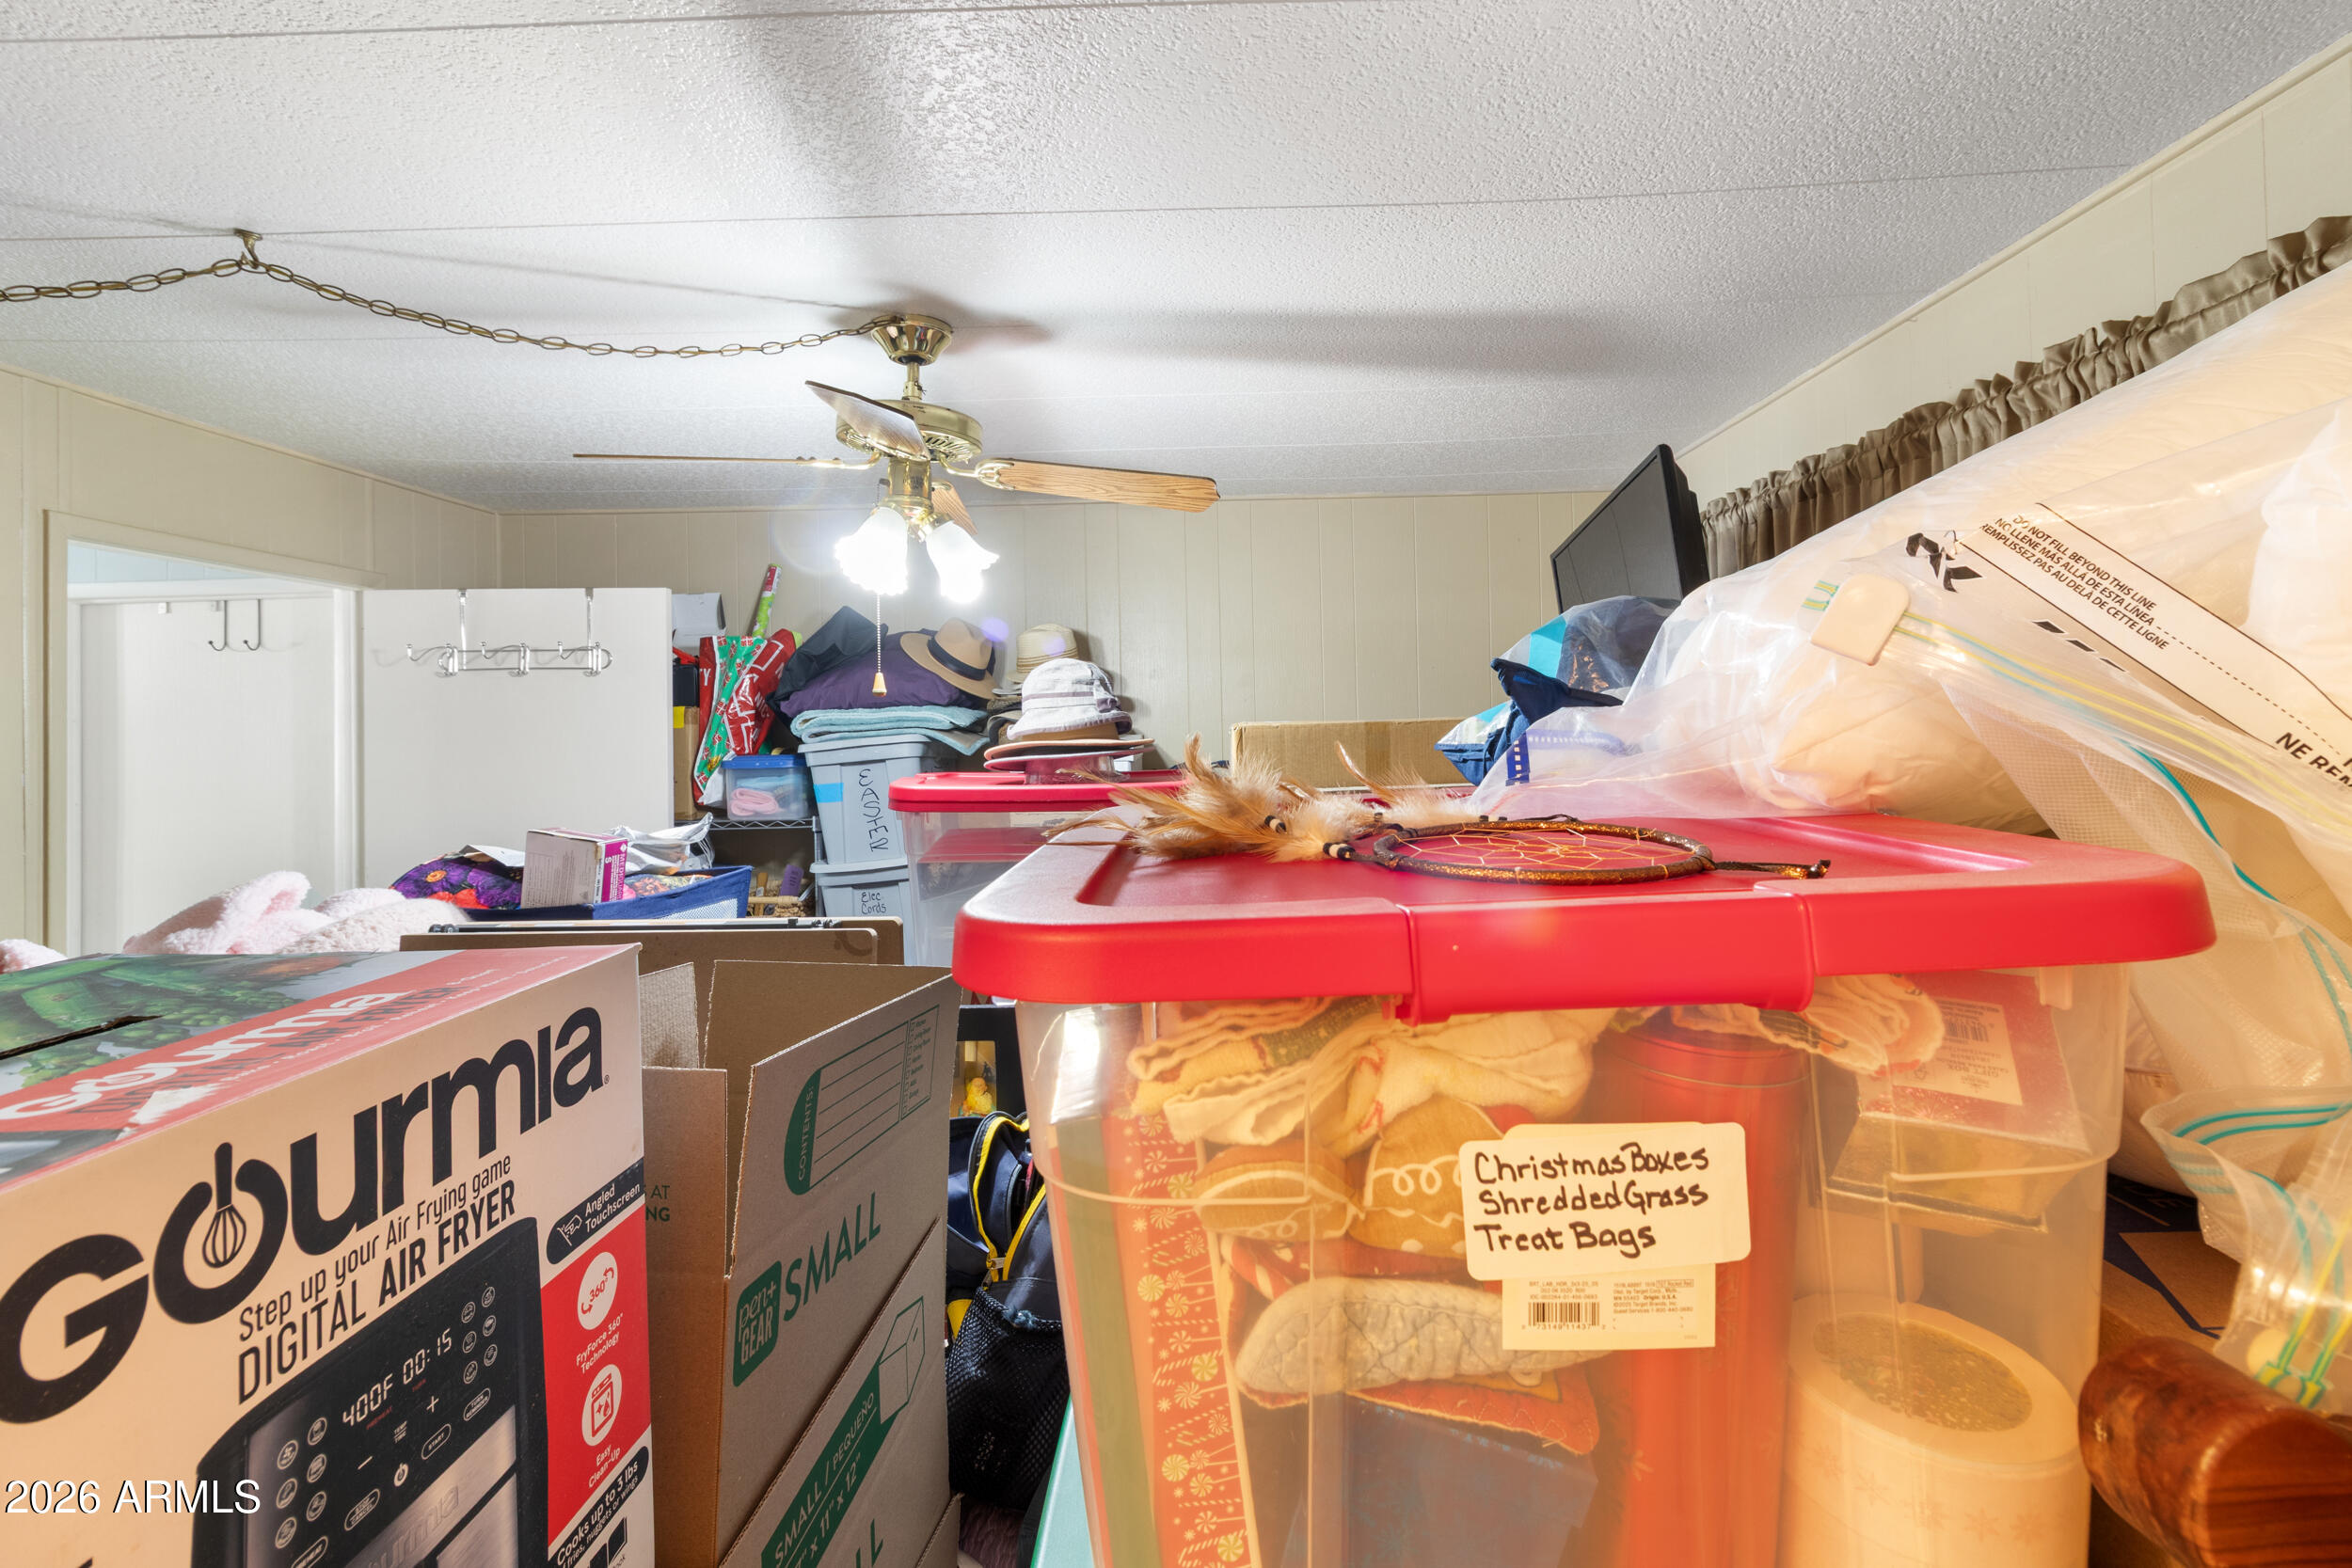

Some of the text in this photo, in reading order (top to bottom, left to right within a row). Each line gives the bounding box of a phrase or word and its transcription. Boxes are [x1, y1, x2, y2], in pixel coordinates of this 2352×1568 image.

[1994, 517, 2154, 626] NO LLENE MÁS ALLÁ DE ESTA LÍNEA
[2012, 515, 2156, 611] DO NOT FILL BEYOND THIS LINE
[2033, 557, 2052, 574] PAS
[2050, 568, 2067, 583] AU
[2090, 595, 2109, 610] DE
[2106, 605, 2137, 631] CETTE
[2135, 627, 2169, 651] LIGNE
[2275, 732, 2313, 760] NE
[858, 768, 889, 852] EASTER
[861, 903, 887, 915] Cords
[799, 1085, 814, 1181] CONTENTS:
[1474, 1141, 1709, 1185] Christmas Boxes
[585, 1182, 615, 1216] Angled
[585, 1183, 641, 1232] Touchscreen
[651, 1185, 670, 1200] AT
[1479, 1180, 1709, 1215] Shredded Grass
[239, 1155, 512, 1342] Step up your Air Frying game
[783, 1192, 882, 1322] SMALL
[1473, 1221, 1656, 1259] Treat Bags
[238, 1179, 516, 1405] DIGITAL AIR FRYER
[576, 1332, 607, 1367] FryForce
[581, 1332, 619, 1374] Technology
[740, 1306, 773, 1365] GEAR
[342, 1372, 393, 1427] 400F
[428, 1433, 445, 1450] START
[588, 1447, 620, 1488] Clean-Up
[596, 1445, 612, 1466] Easy
[557, 1520, 590, 1566] Cooks
[591, 1503, 604, 1525] up
[605, 1489, 616, 1507] to
[617, 1475, 624, 1491] 3
[625, 1461, 638, 1482] lbs
[586, 1507, 612, 1544] nuggets
[612, 1497, 620, 1510] or
[620, 1475, 638, 1500] wings
[774, 1481, 822, 1563] SMALL
